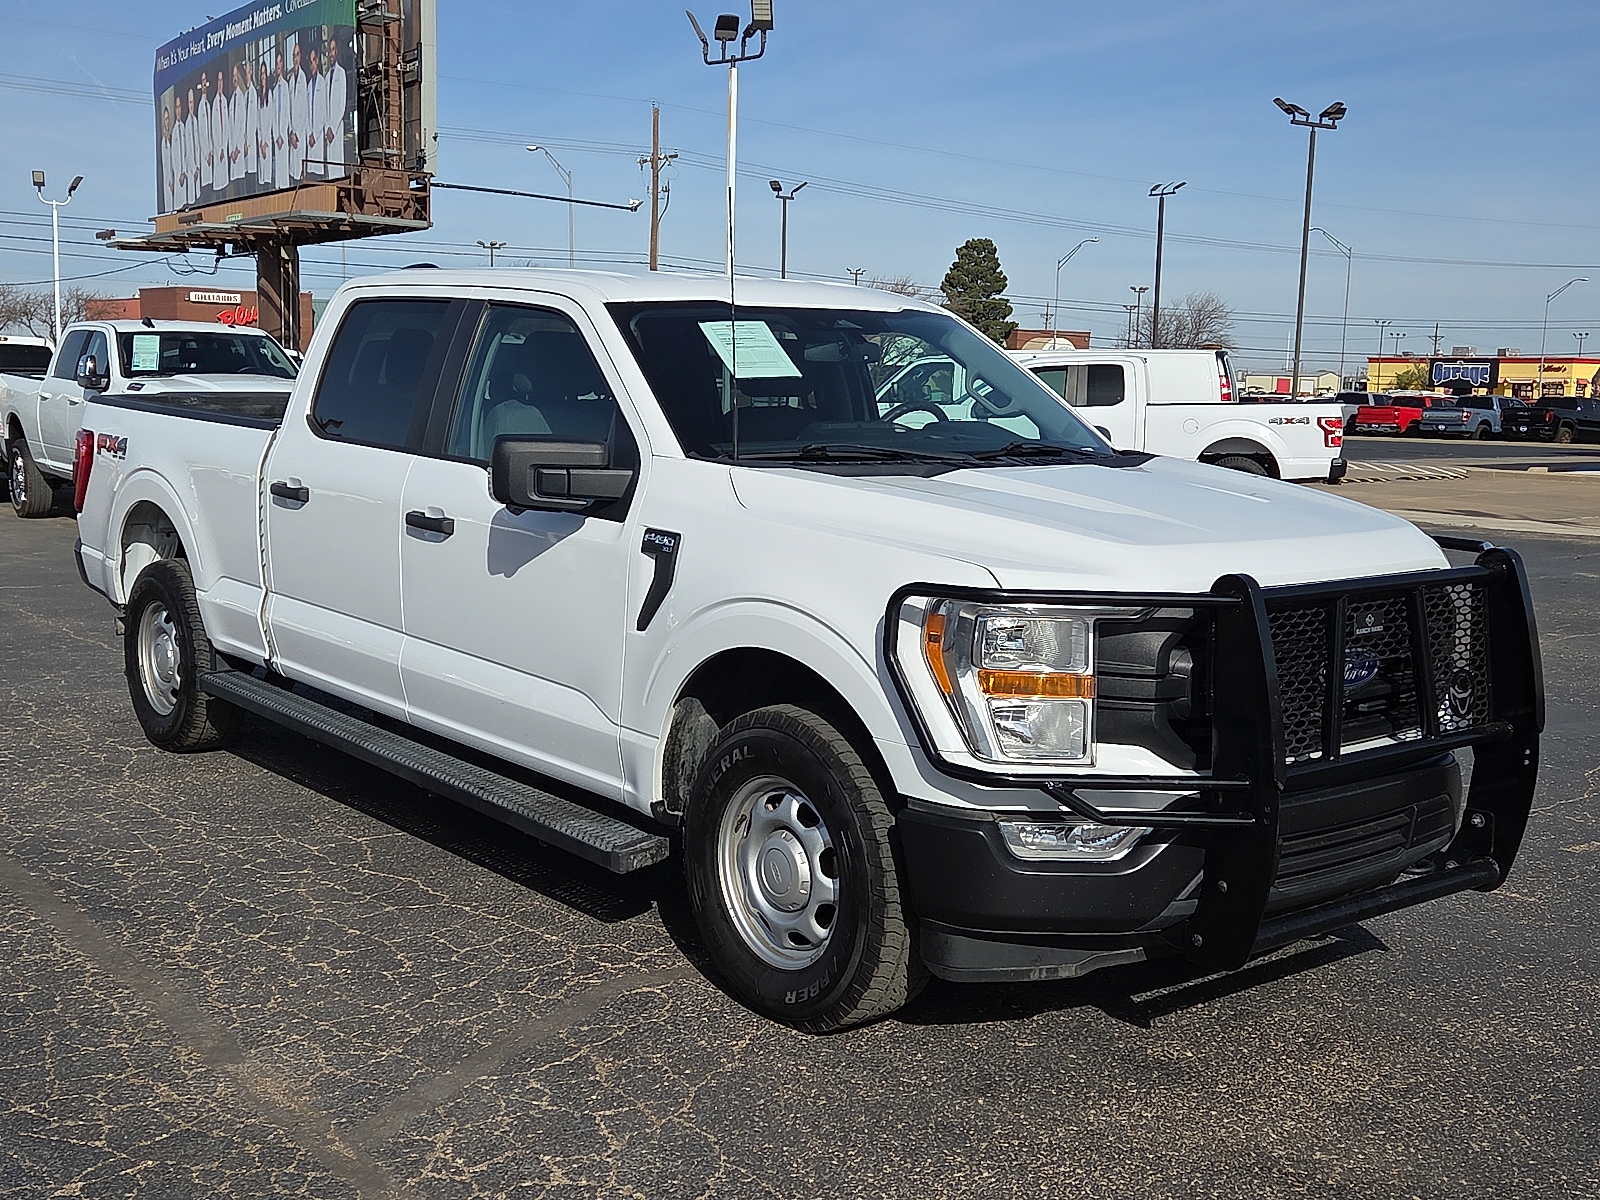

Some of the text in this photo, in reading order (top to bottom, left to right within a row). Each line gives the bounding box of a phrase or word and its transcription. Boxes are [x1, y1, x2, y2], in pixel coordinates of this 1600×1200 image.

[157, 53, 170, 71] When
[170, 49, 178, 67] It's
[178, 46, 190, 62] Your
[190, 38, 206, 57] Heart,
[206, 29, 226, 49] Every
[225, 14, 253, 41] Moment
[253, 3, 283, 29] Matters.
[194, 293, 238, 302] BILLIARDS
[1433, 361, 1491, 386] Garage
[97, 433, 128, 457] FX4
